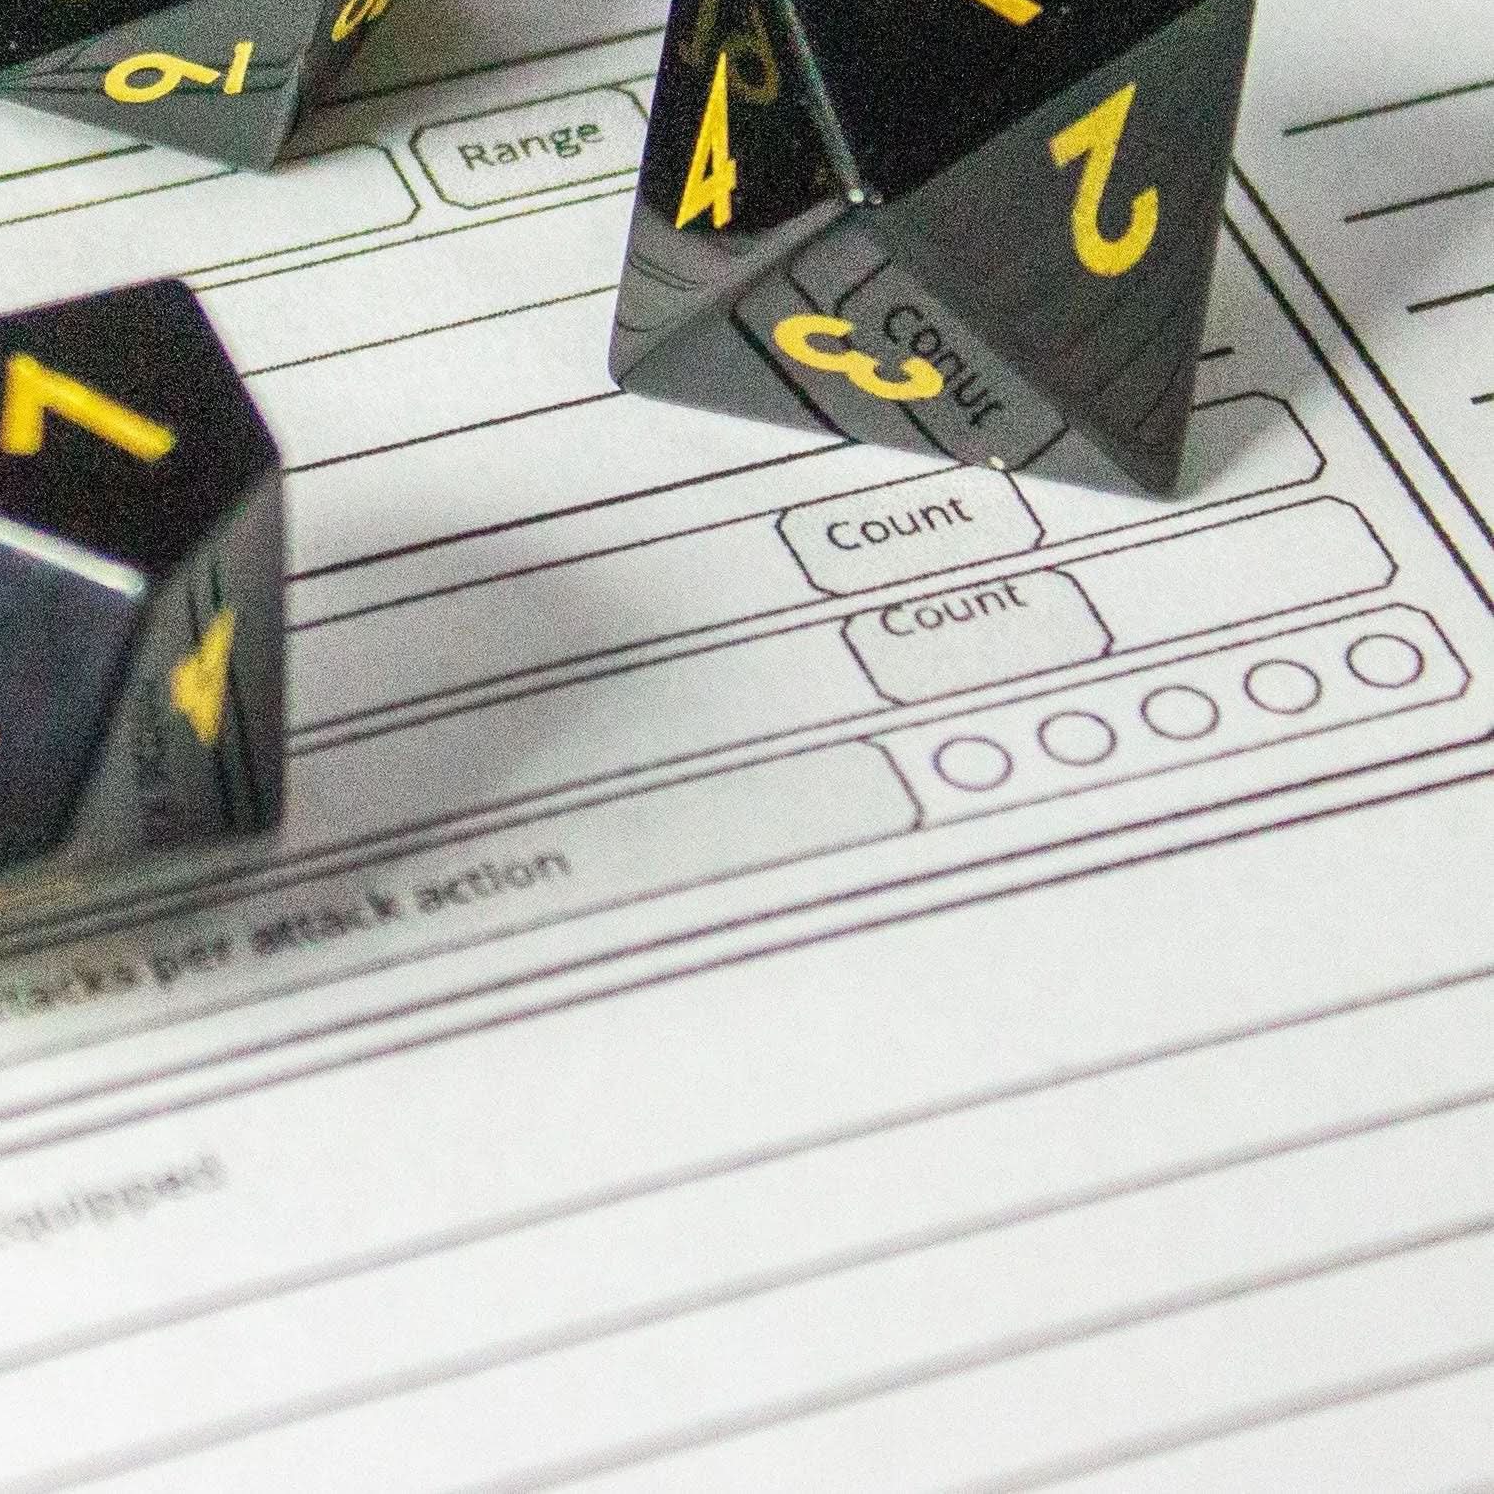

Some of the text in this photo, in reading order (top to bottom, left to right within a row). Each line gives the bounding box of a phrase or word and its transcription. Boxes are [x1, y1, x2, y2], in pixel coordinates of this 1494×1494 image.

[457, 122, 604, 171] Range
[673, 50, 738, 230] 4
[1049, 83, 1160, 278] 2
[772, 312, 946, 402] 3
[825, 495, 973, 553] Count
[879, 580, 1028, 639] Count
[151, 933, 233, 992] per
[251, 889, 402, 958] attack
[413, 848, 572, 916] action
